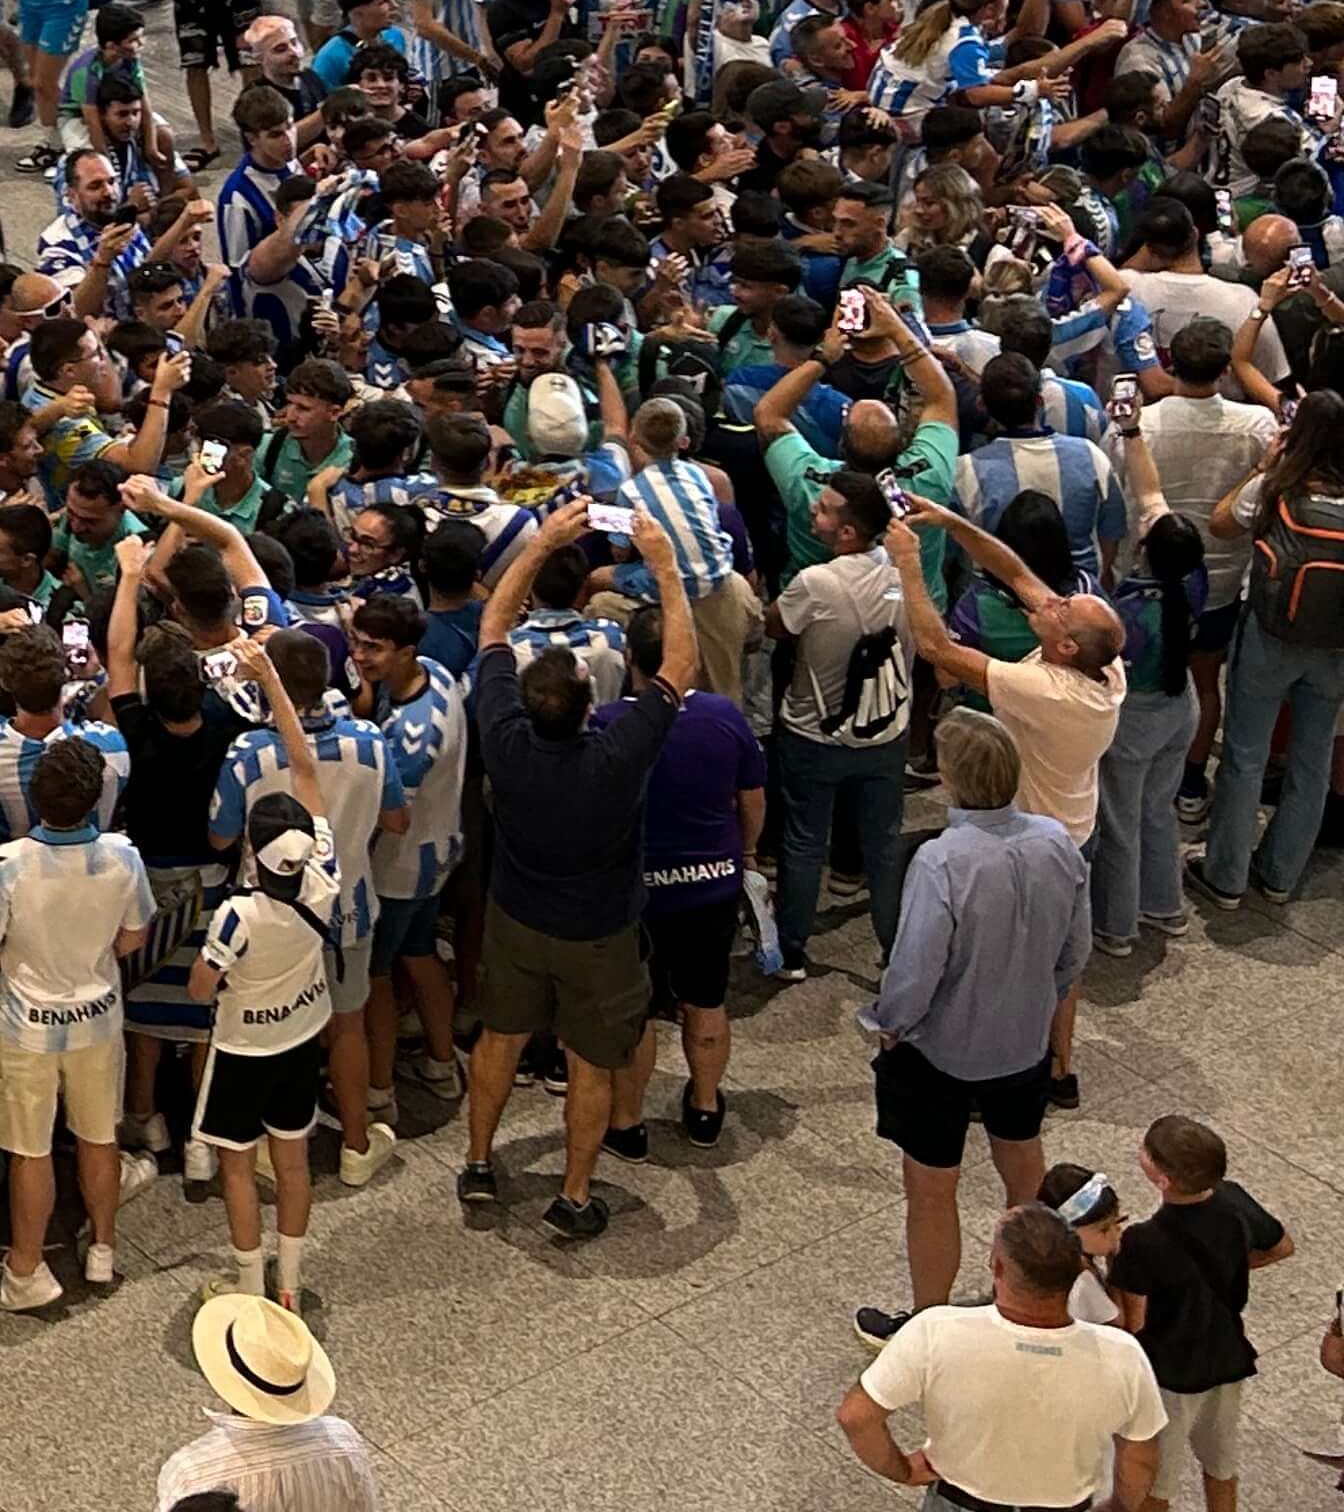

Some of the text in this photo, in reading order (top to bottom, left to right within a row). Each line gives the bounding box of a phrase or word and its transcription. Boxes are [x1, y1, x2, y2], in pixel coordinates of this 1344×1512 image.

[642, 857, 736, 888] ENAHAVIS
[28, 991, 117, 1026] BENAHAVIS
[242, 976, 326, 1026] BENAAVIS
